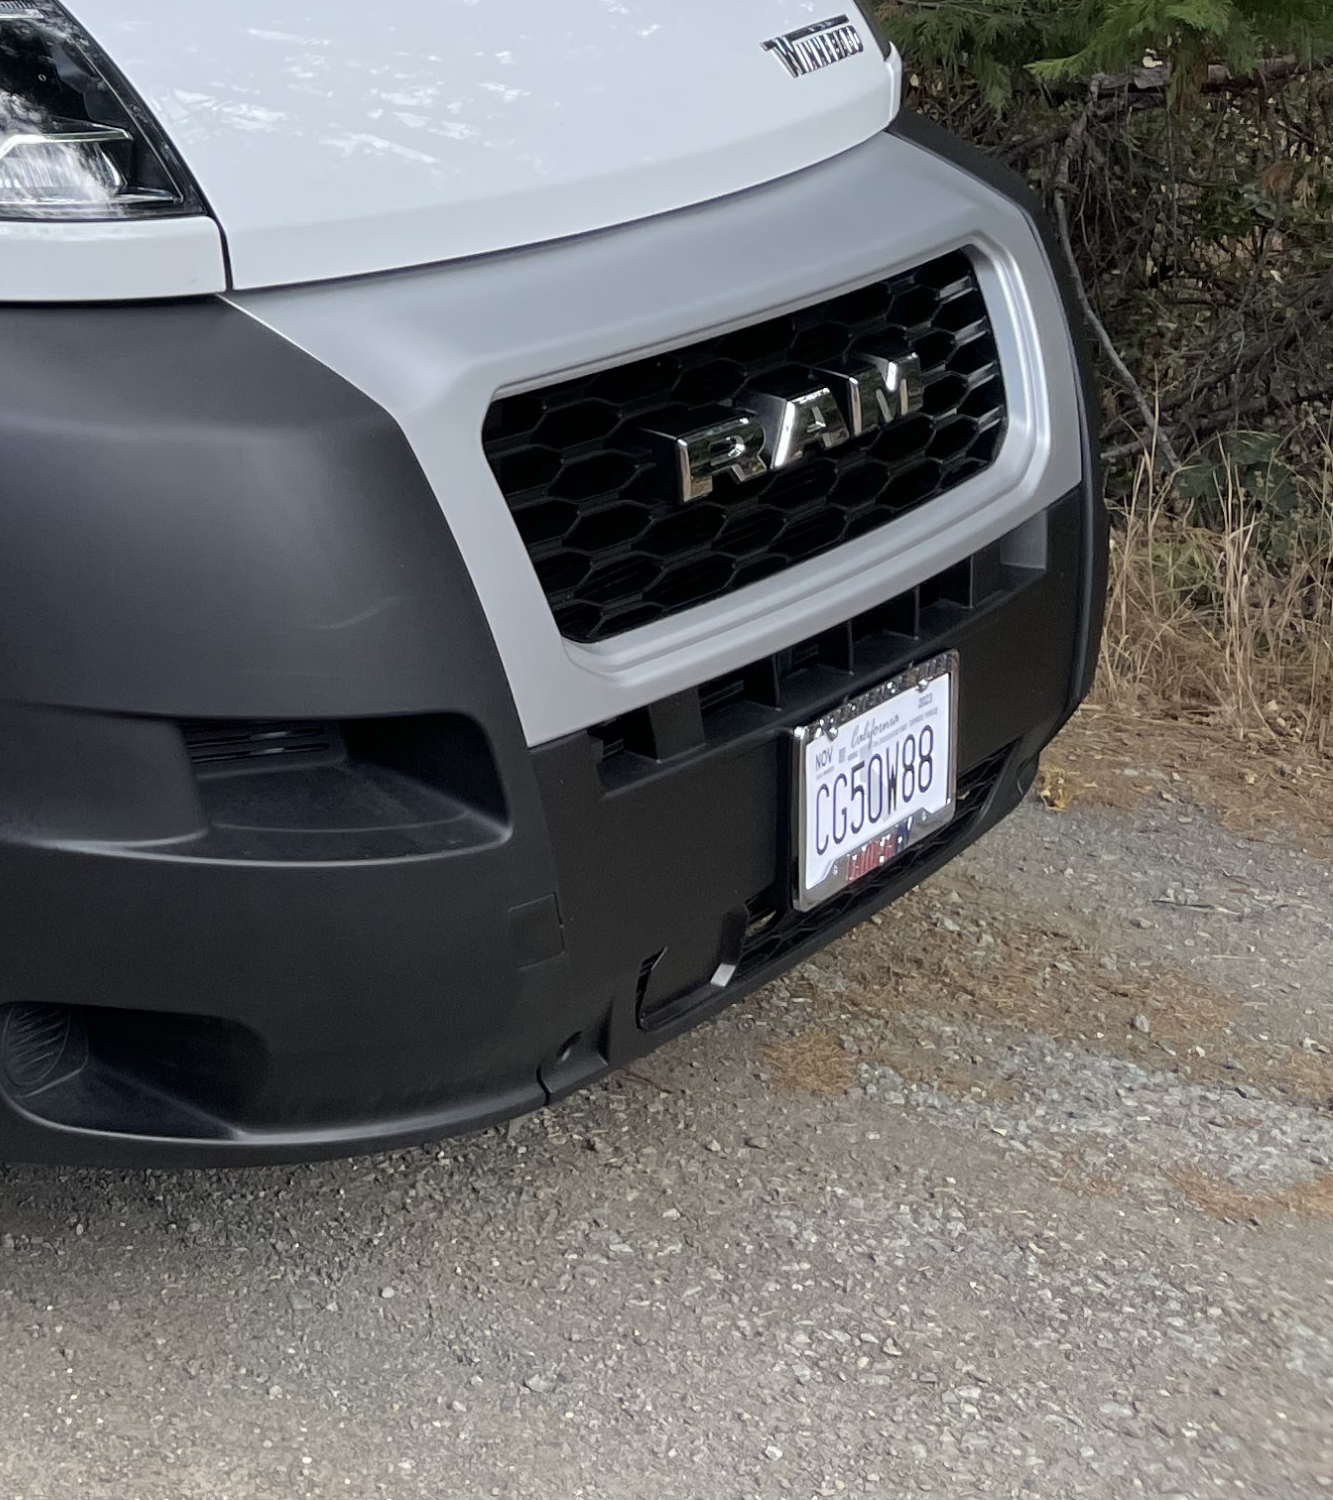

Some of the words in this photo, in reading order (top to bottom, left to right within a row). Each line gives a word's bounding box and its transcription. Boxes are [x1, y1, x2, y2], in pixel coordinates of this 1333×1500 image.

[677, 351, 924, 502] RAM
[815, 745, 834, 772] NOV
[815, 724, 934, 856] CG50W88
